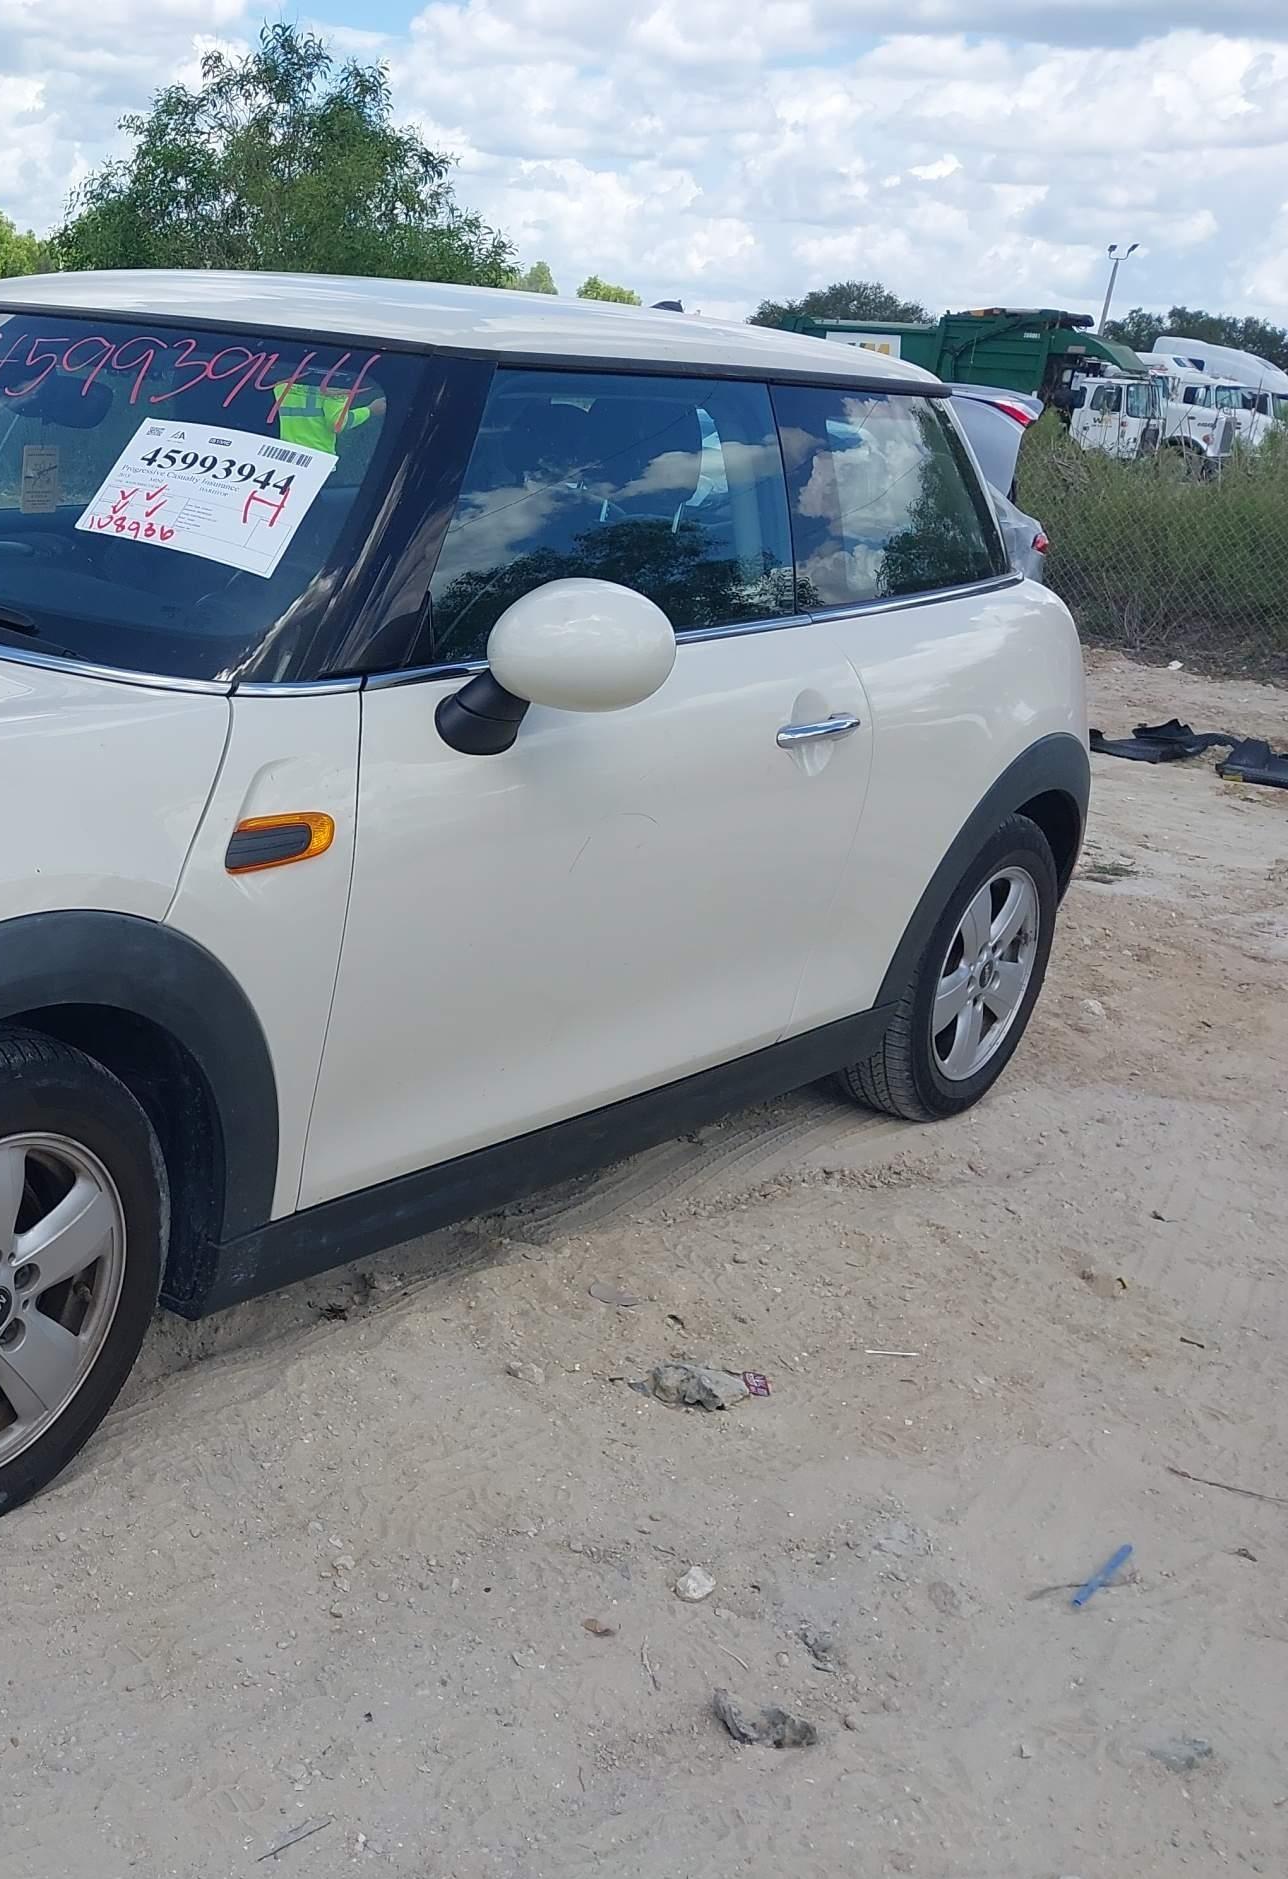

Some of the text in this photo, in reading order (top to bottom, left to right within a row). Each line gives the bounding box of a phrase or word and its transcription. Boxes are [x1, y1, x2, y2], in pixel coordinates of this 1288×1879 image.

[121, 464, 240, 493] Progressive Casualty Insurance
[140, 447, 296, 495] 45993944
